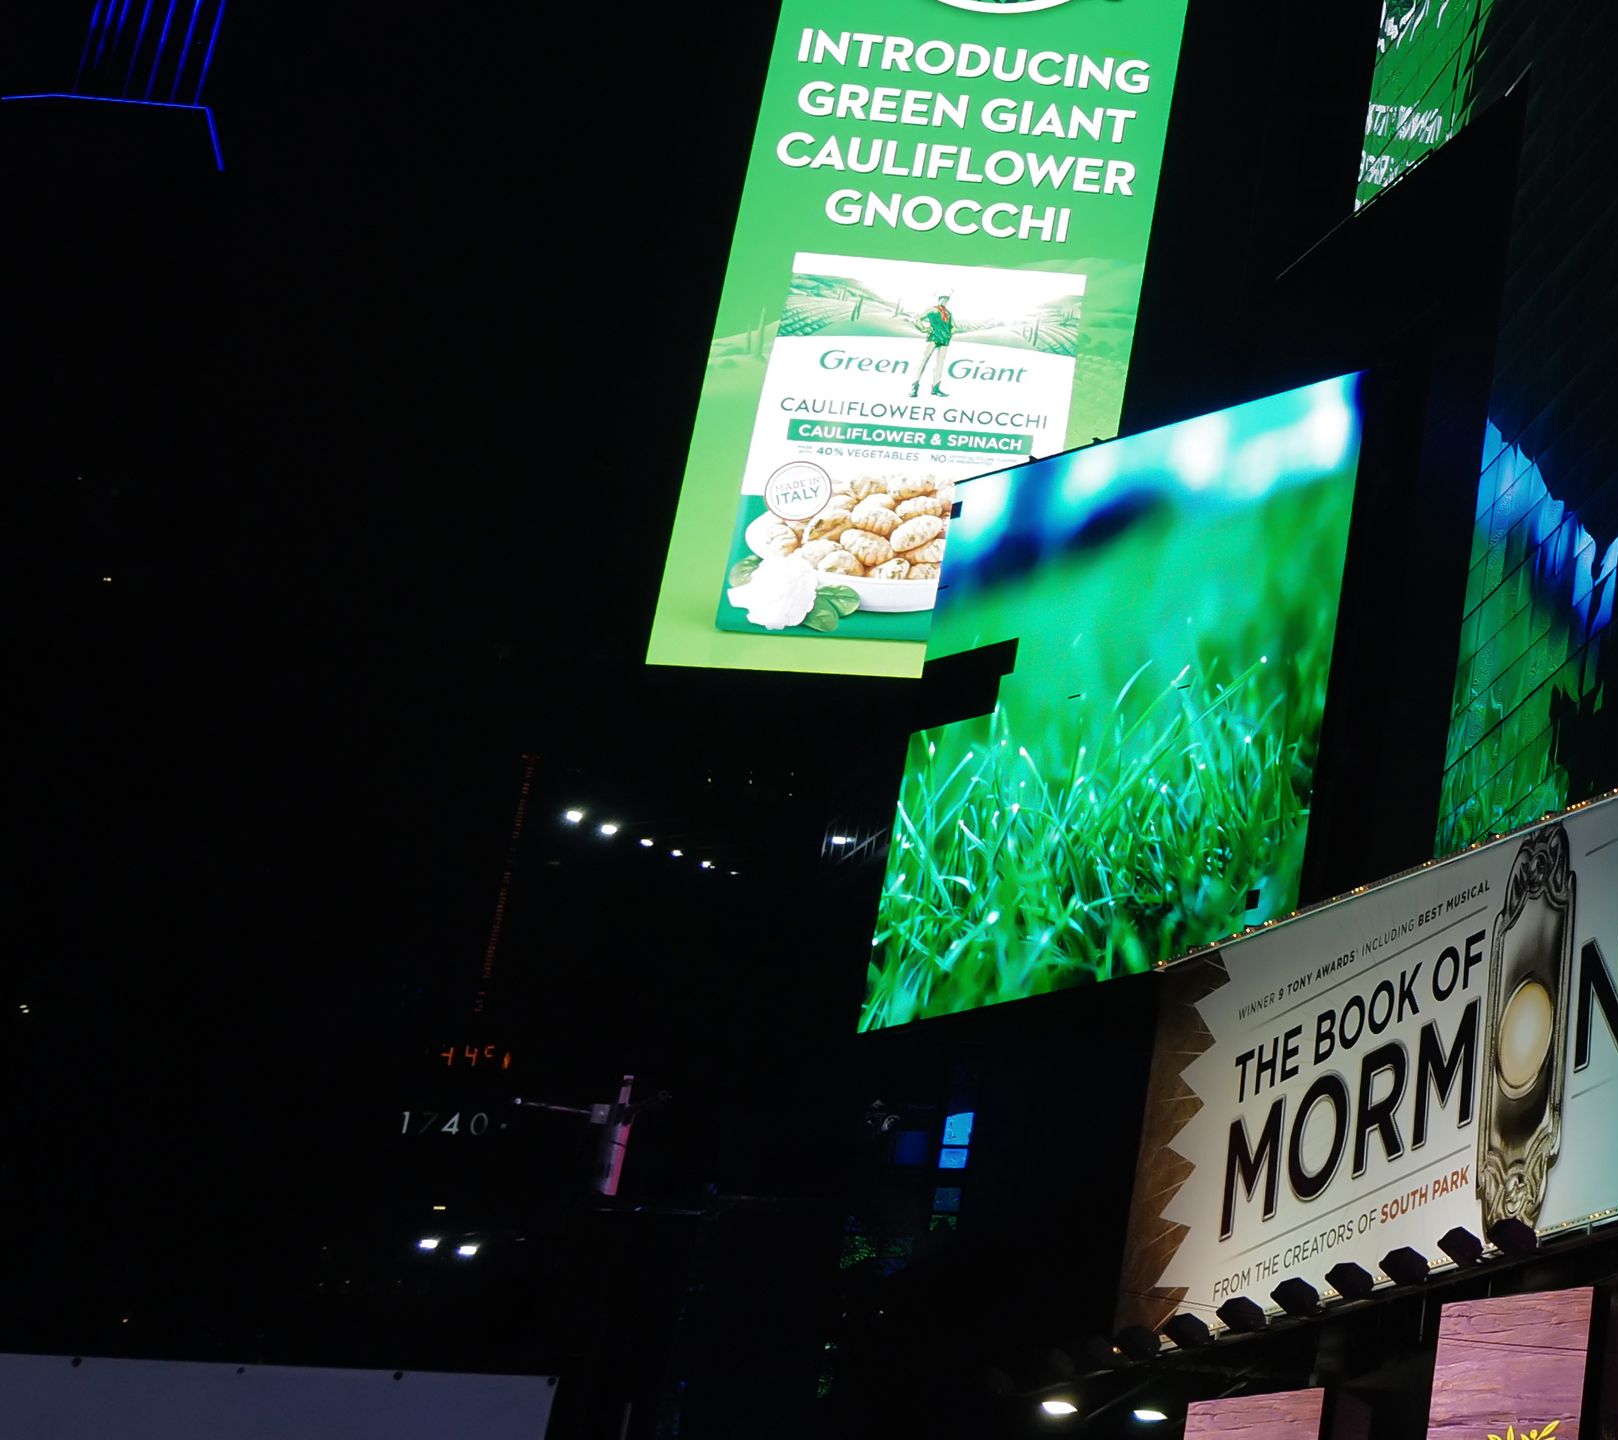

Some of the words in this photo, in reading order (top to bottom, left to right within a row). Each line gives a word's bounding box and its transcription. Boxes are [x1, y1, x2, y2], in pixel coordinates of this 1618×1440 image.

[797, 28, 1151, 94] INTRODUCING
[798, 81, 968, 128] GREEN
[981, 98, 1136, 144] GIANT
[776, 132, 1136, 196] CAULIFLOWER
[824, 190, 1071, 243] GNOCCHI
[819, 349, 909, 375] Green
[947, 358, 1027, 384] Giant
[780, 397, 936, 421] CAULIFLOWER
[943, 408, 1048, 430] GNOCCHI
[798, 424, 926, 445] CAULIFLOWER
[930, 433, 942, 446] &
[947, 434, 1022, 452] SPINACH
[816, 446, 844, 457] 40%
[847, 448, 920, 462] VEGETABLES
[930, 454, 947, 464] NO
[775, 485, 821, 506] ITALY
[1238, 992, 1275, 1020] WINNER
[1278, 988, 1284, 1000] 9
[1286, 973, 1312, 995] TONY
[1361, 920, 1415, 957] INCLUDING
[1418, 903, 1443, 927] BEST
[1445, 880, 1490, 913] MUSICAL
[1235, 1025, 1302, 1103] THE
[1314, 961, 1422, 1065] BOOK
[1432, 929, 1487, 1002] OF
[1212, 1267, 1251, 1302] FROM
[1255, 1255, 1279, 1282] THE
[1283, 1220, 1354, 1269] CREATORS
[1357, 1208, 1377, 1234] OF
[1380, 1184, 1428, 1224] SOUTH
[1432, 1165, 1470, 1201] PARK
